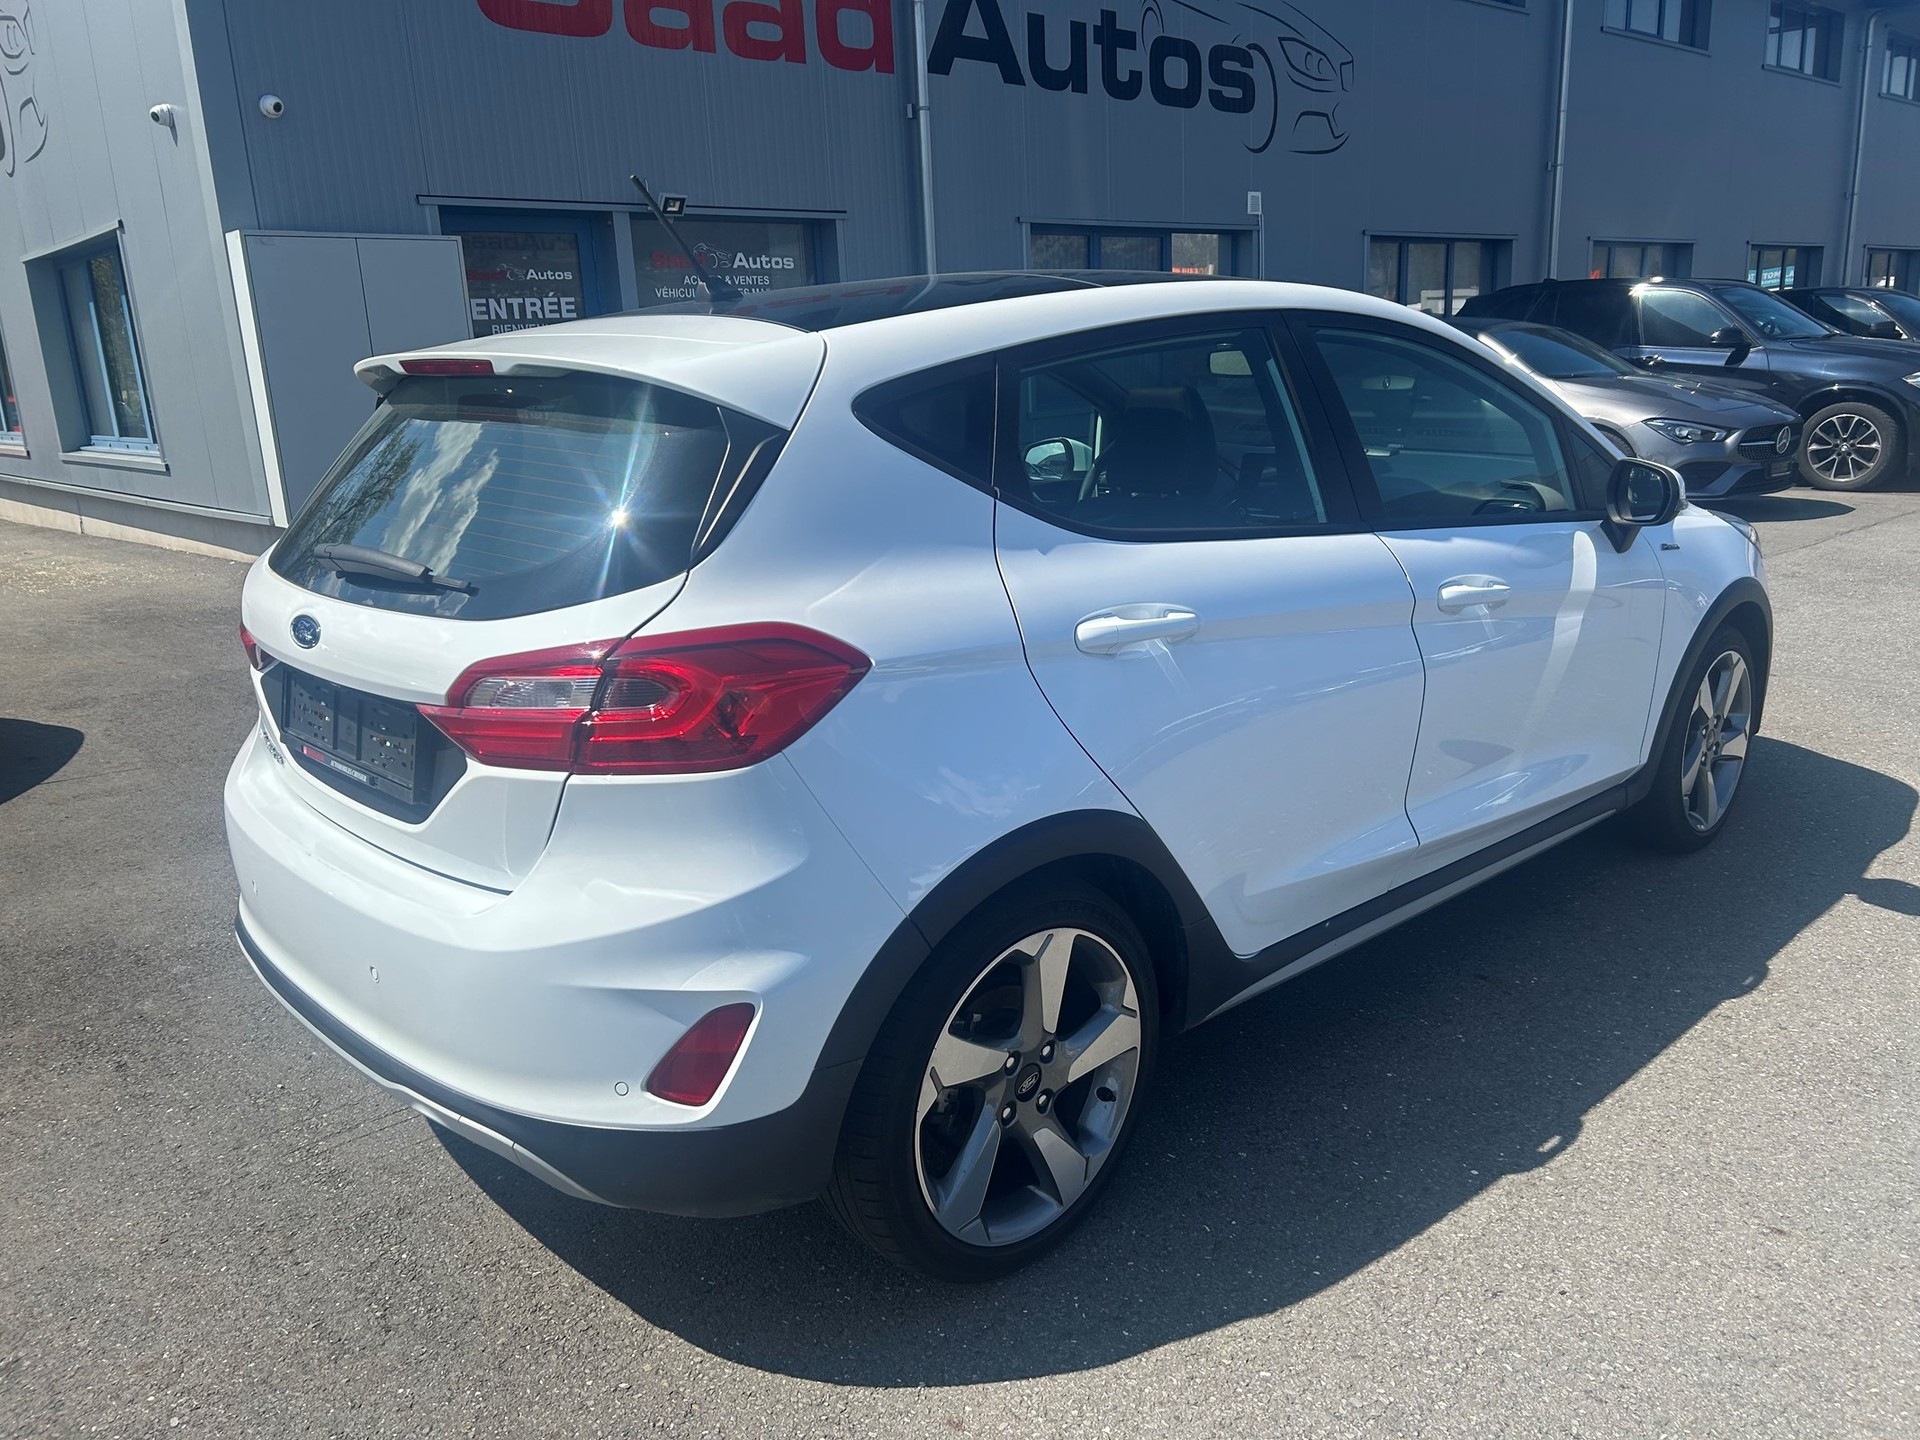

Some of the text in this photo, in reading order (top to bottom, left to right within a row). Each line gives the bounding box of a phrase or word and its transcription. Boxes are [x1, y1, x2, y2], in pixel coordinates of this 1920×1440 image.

[927, 0, 1256, 114] Autos
[733, 252, 794, 269] Autos
[526, 269, 573, 280] Autos
[733, 275, 770, 285] VENTES
[470, 291, 577, 320] ENTRÉE
